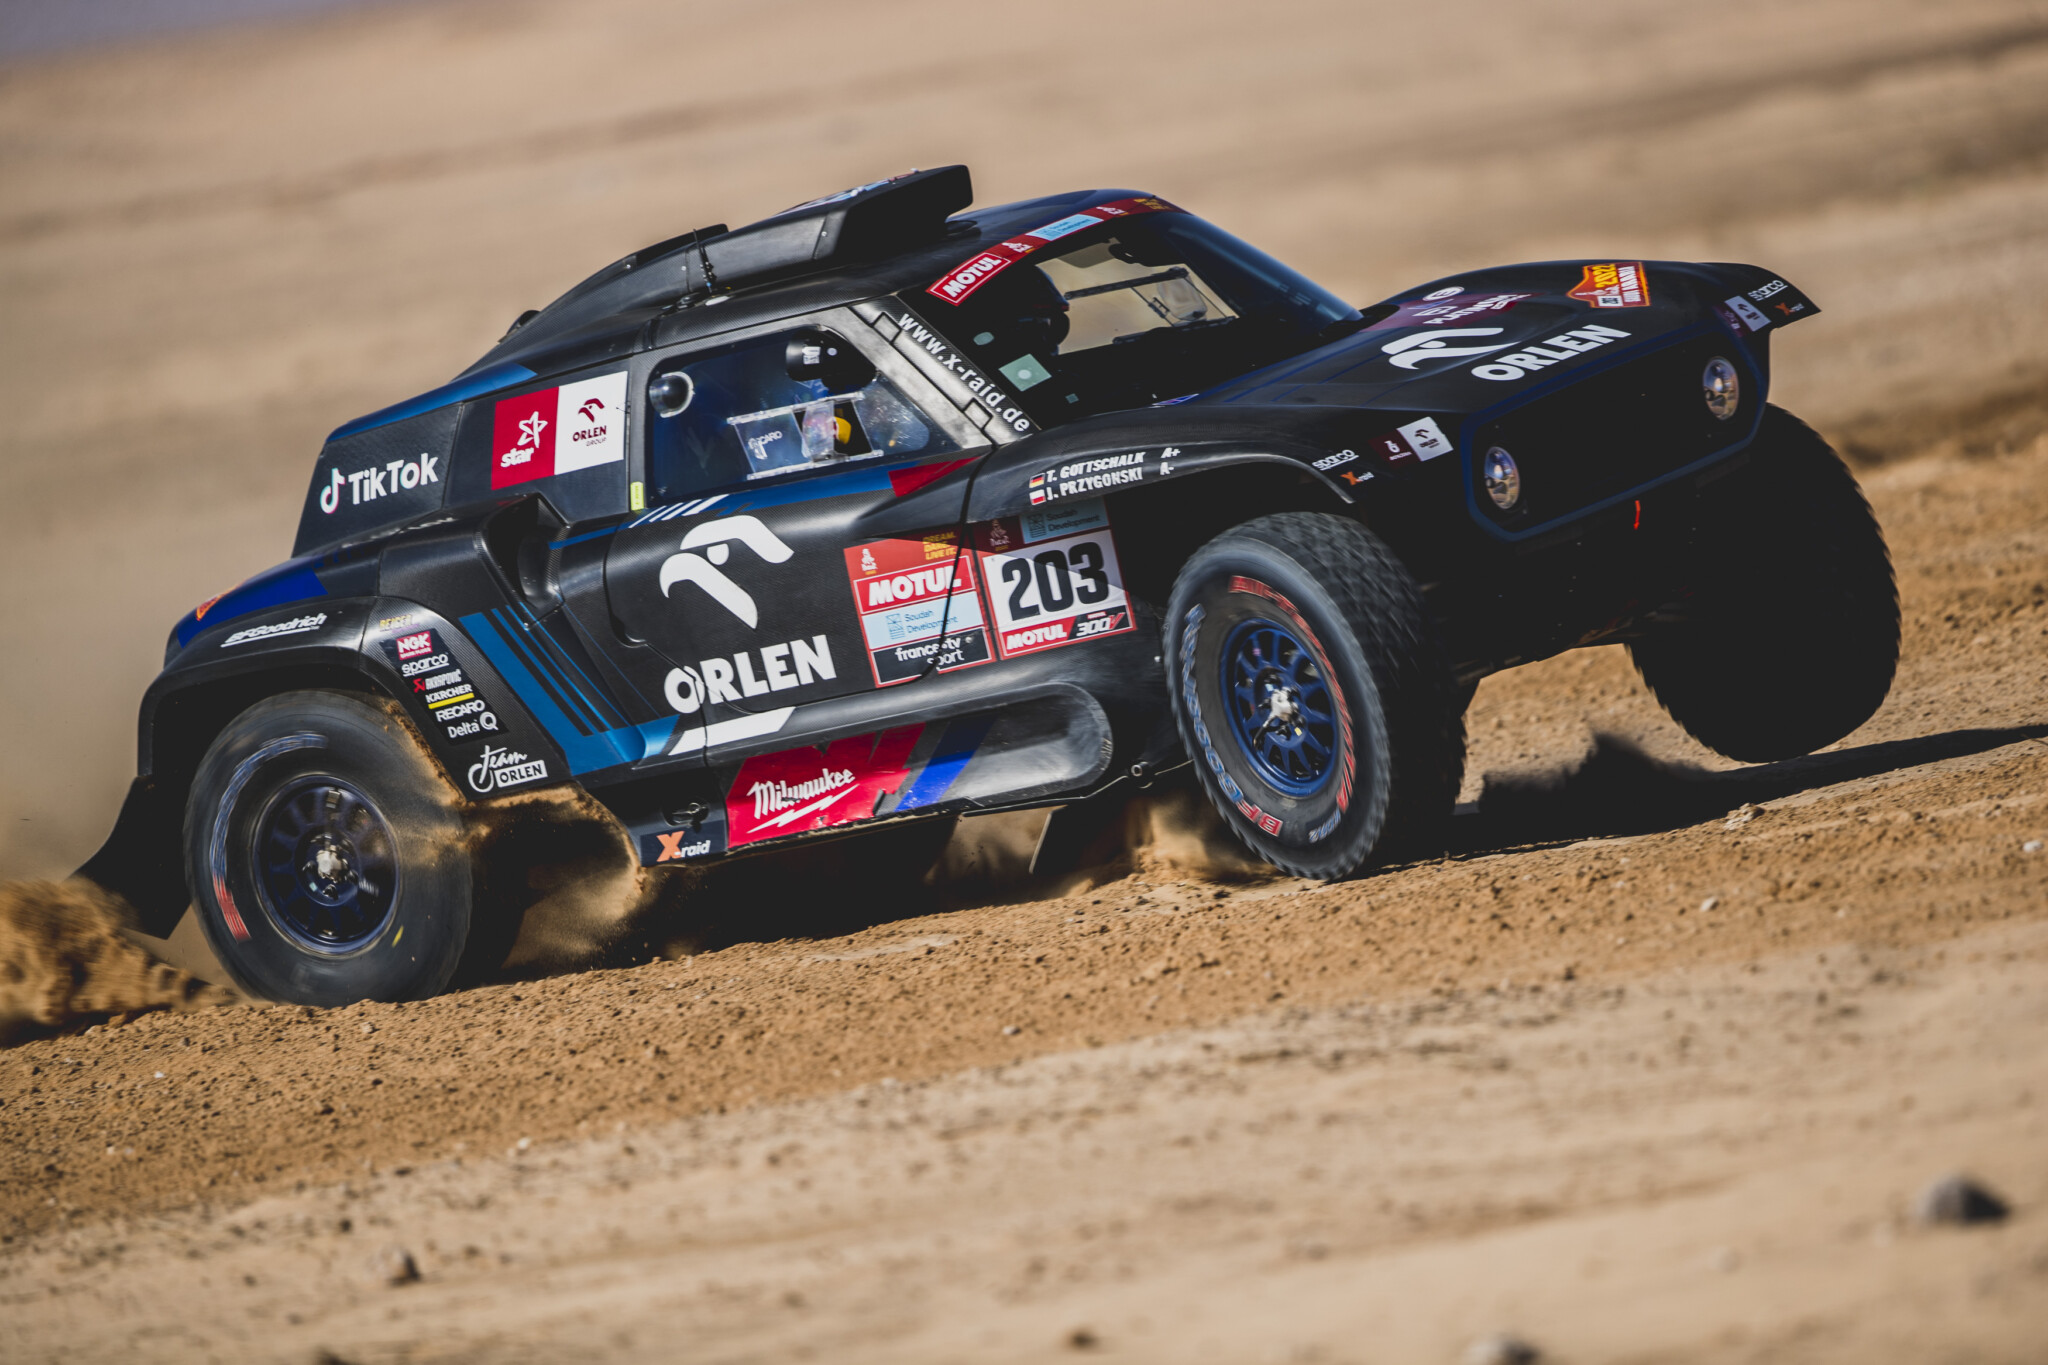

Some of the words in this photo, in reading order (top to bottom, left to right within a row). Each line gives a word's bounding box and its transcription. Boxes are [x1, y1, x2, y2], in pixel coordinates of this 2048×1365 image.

[942, 255, 1002, 298] MOTUL
[1471, 324, 1632, 381] ORLEN
[898, 313, 1030, 432] www.x-raid.de
[572, 425, 607, 442] ORLEN
[500, 447, 534, 468] star
[1046, 470, 1058, 483] T.
[1060, 451, 1146, 479] GOTTSCHALK
[1161, 447, 1181, 459] A+
[1312, 449, 1357, 471] sparco
[348, 452, 439, 507] TikTok
[1046, 486, 1059, 501] J.
[1160, 461, 1175, 476] A-
[868, 565, 962, 607] MOTUL
[1001, 541, 1109, 621] 203
[224, 612, 328, 644] BFGoodrich
[1006, 623, 1068, 650] MOTUL
[1076, 612, 1126, 637] 300V
[397, 633, 431, 654] NGK
[401, 653, 449, 675] sparco
[663, 634, 837, 714] ORLEN
[435, 699, 485, 722] RECARO
[468, 744, 528, 793] team
[499, 763, 543, 784] ORLEN
[746, 768, 856, 820] Milwaukee
[656, 830, 711, 862] X-raid
